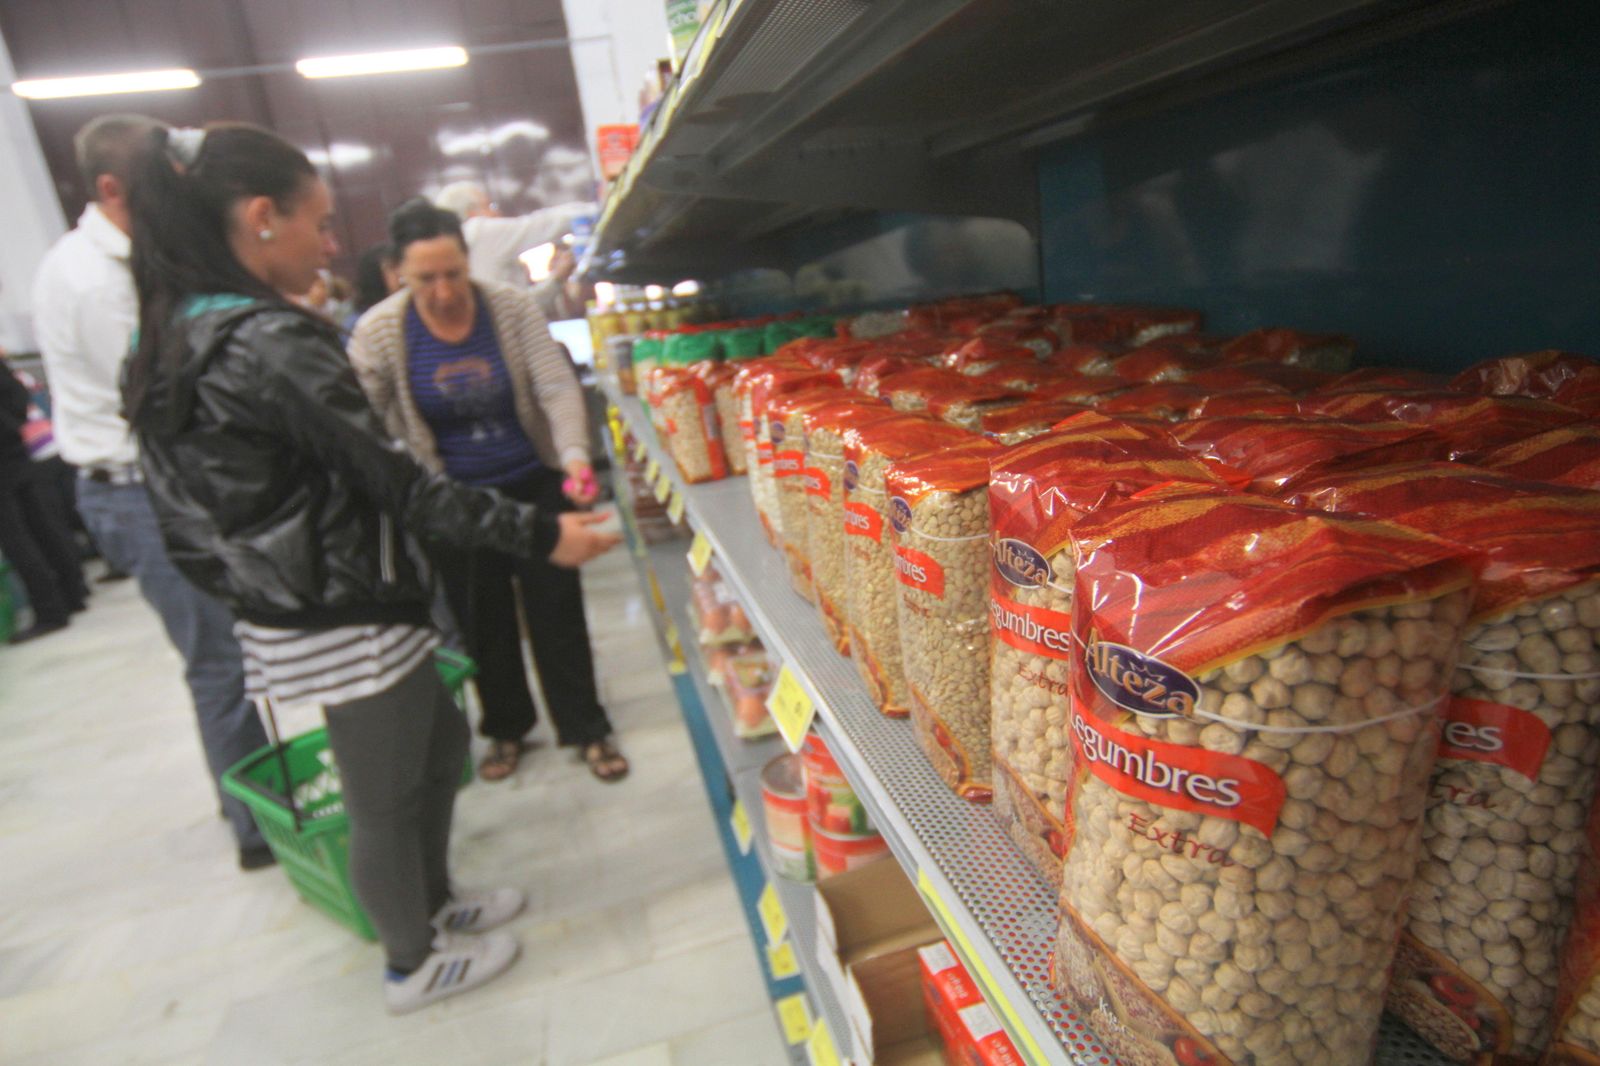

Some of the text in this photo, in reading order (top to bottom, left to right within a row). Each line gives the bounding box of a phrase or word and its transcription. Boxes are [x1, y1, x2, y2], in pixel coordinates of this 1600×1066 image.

[992, 529, 1048, 588] Alteza
[991, 598, 1071, 652] egumbres
[1085, 627, 1195, 719] Alteza
[1445, 722, 1504, 751] es
[1128, 811, 1235, 867] Extra
